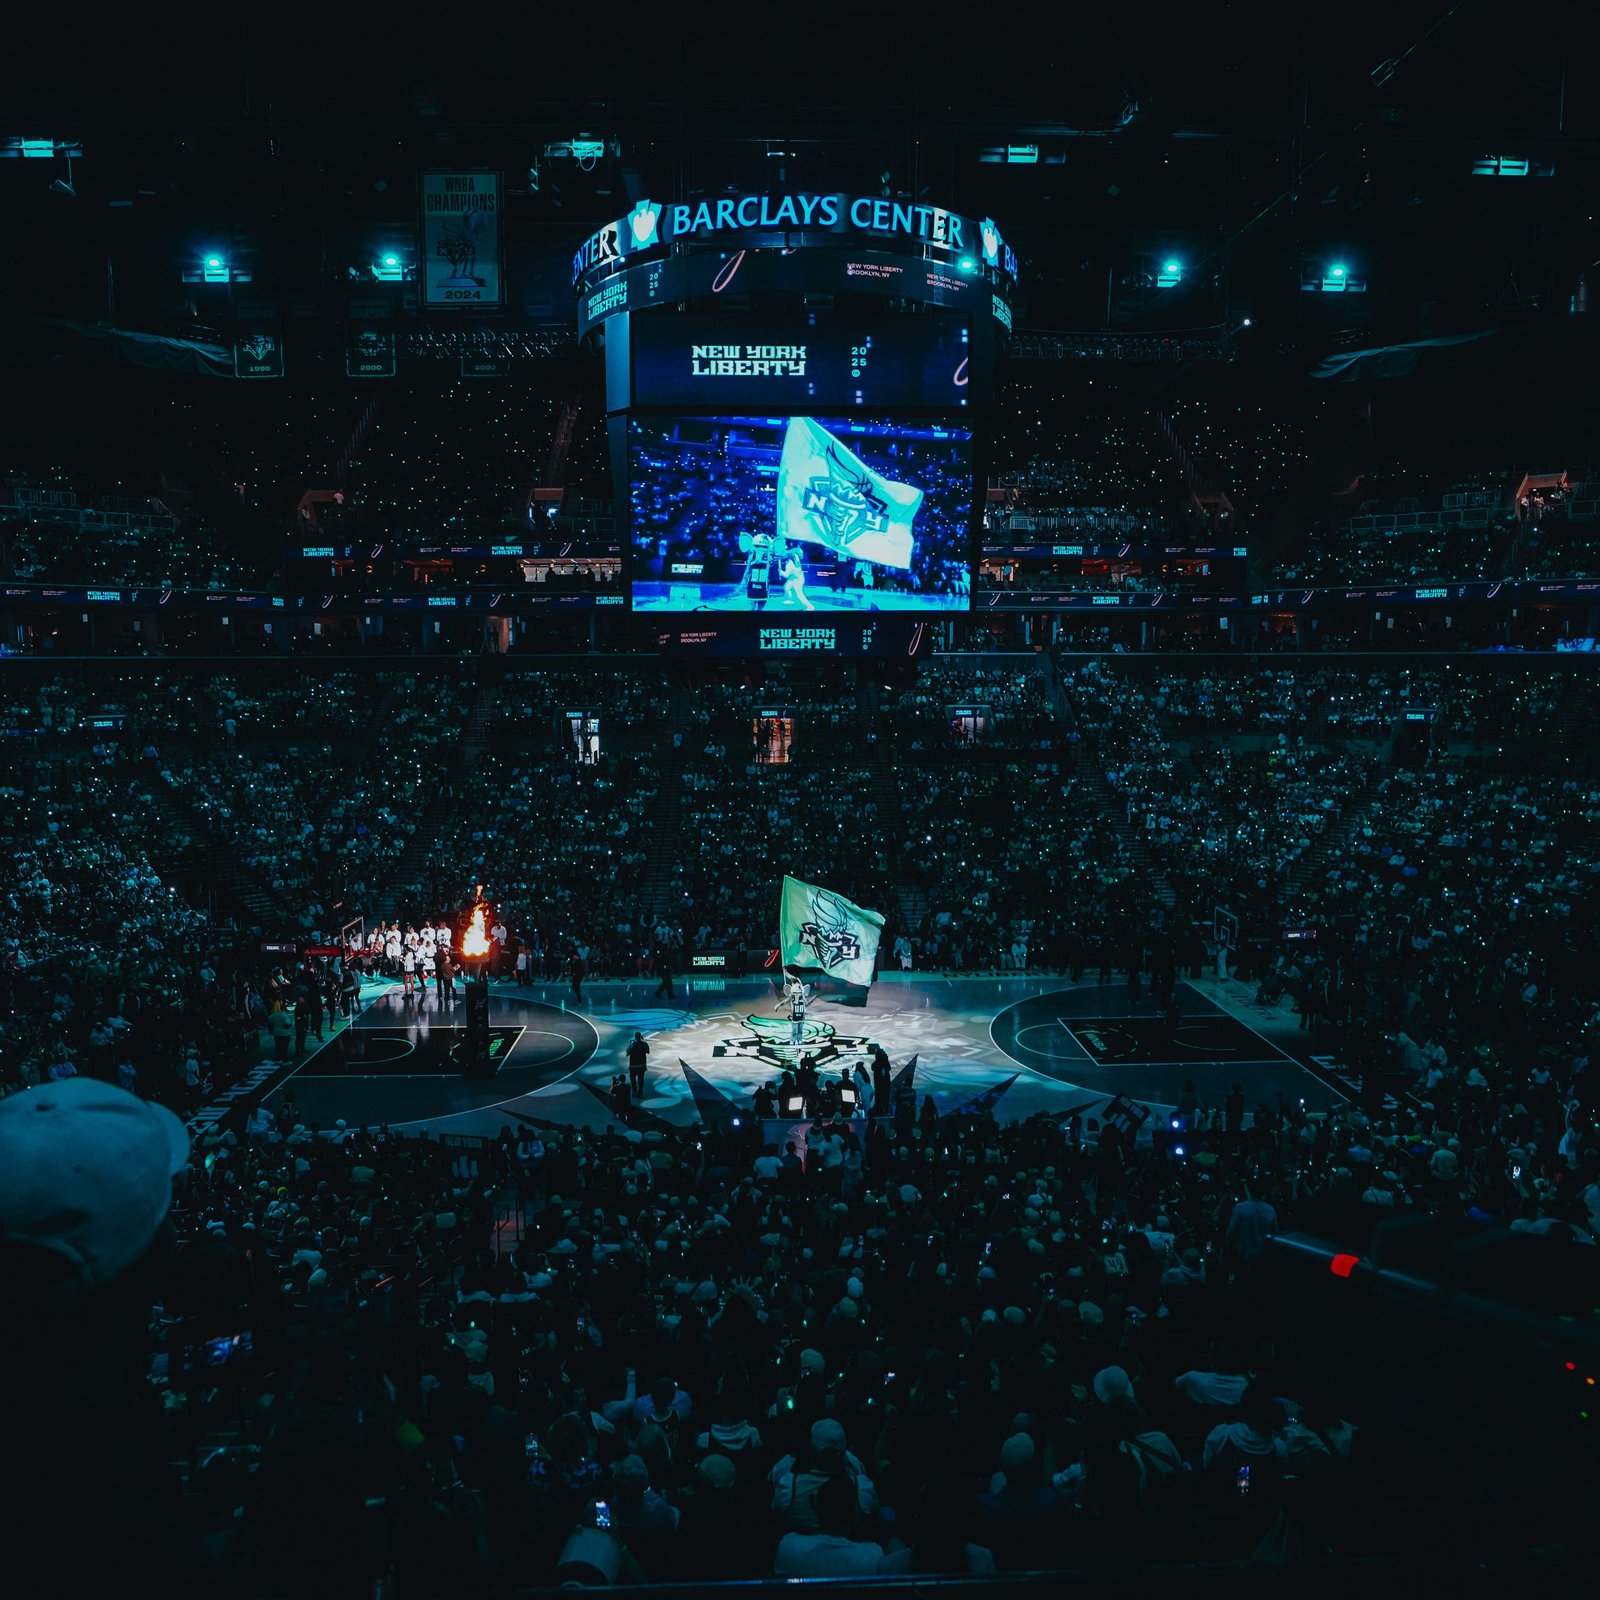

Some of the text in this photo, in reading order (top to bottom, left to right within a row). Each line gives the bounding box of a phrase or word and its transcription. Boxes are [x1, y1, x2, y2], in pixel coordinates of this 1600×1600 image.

[445, 177, 475, 192] WNBA
[427, 194, 495, 212] CHAMPIONS
[673, 195, 965, 248] BARCLAYS CENTER
[445, 290, 481, 299] 2024
[588, 281, 627, 308] NEW YORK
[588, 292, 627, 320] LIBERTY
[692, 345, 806, 359] NEW YORK
[851, 347, 867, 355] 20
[692, 360, 806, 376] LIBERTY
[851, 358, 867, 366] 25
[760, 629, 836, 637] NEW YORK
[760, 639, 836, 649] LIBERTY
